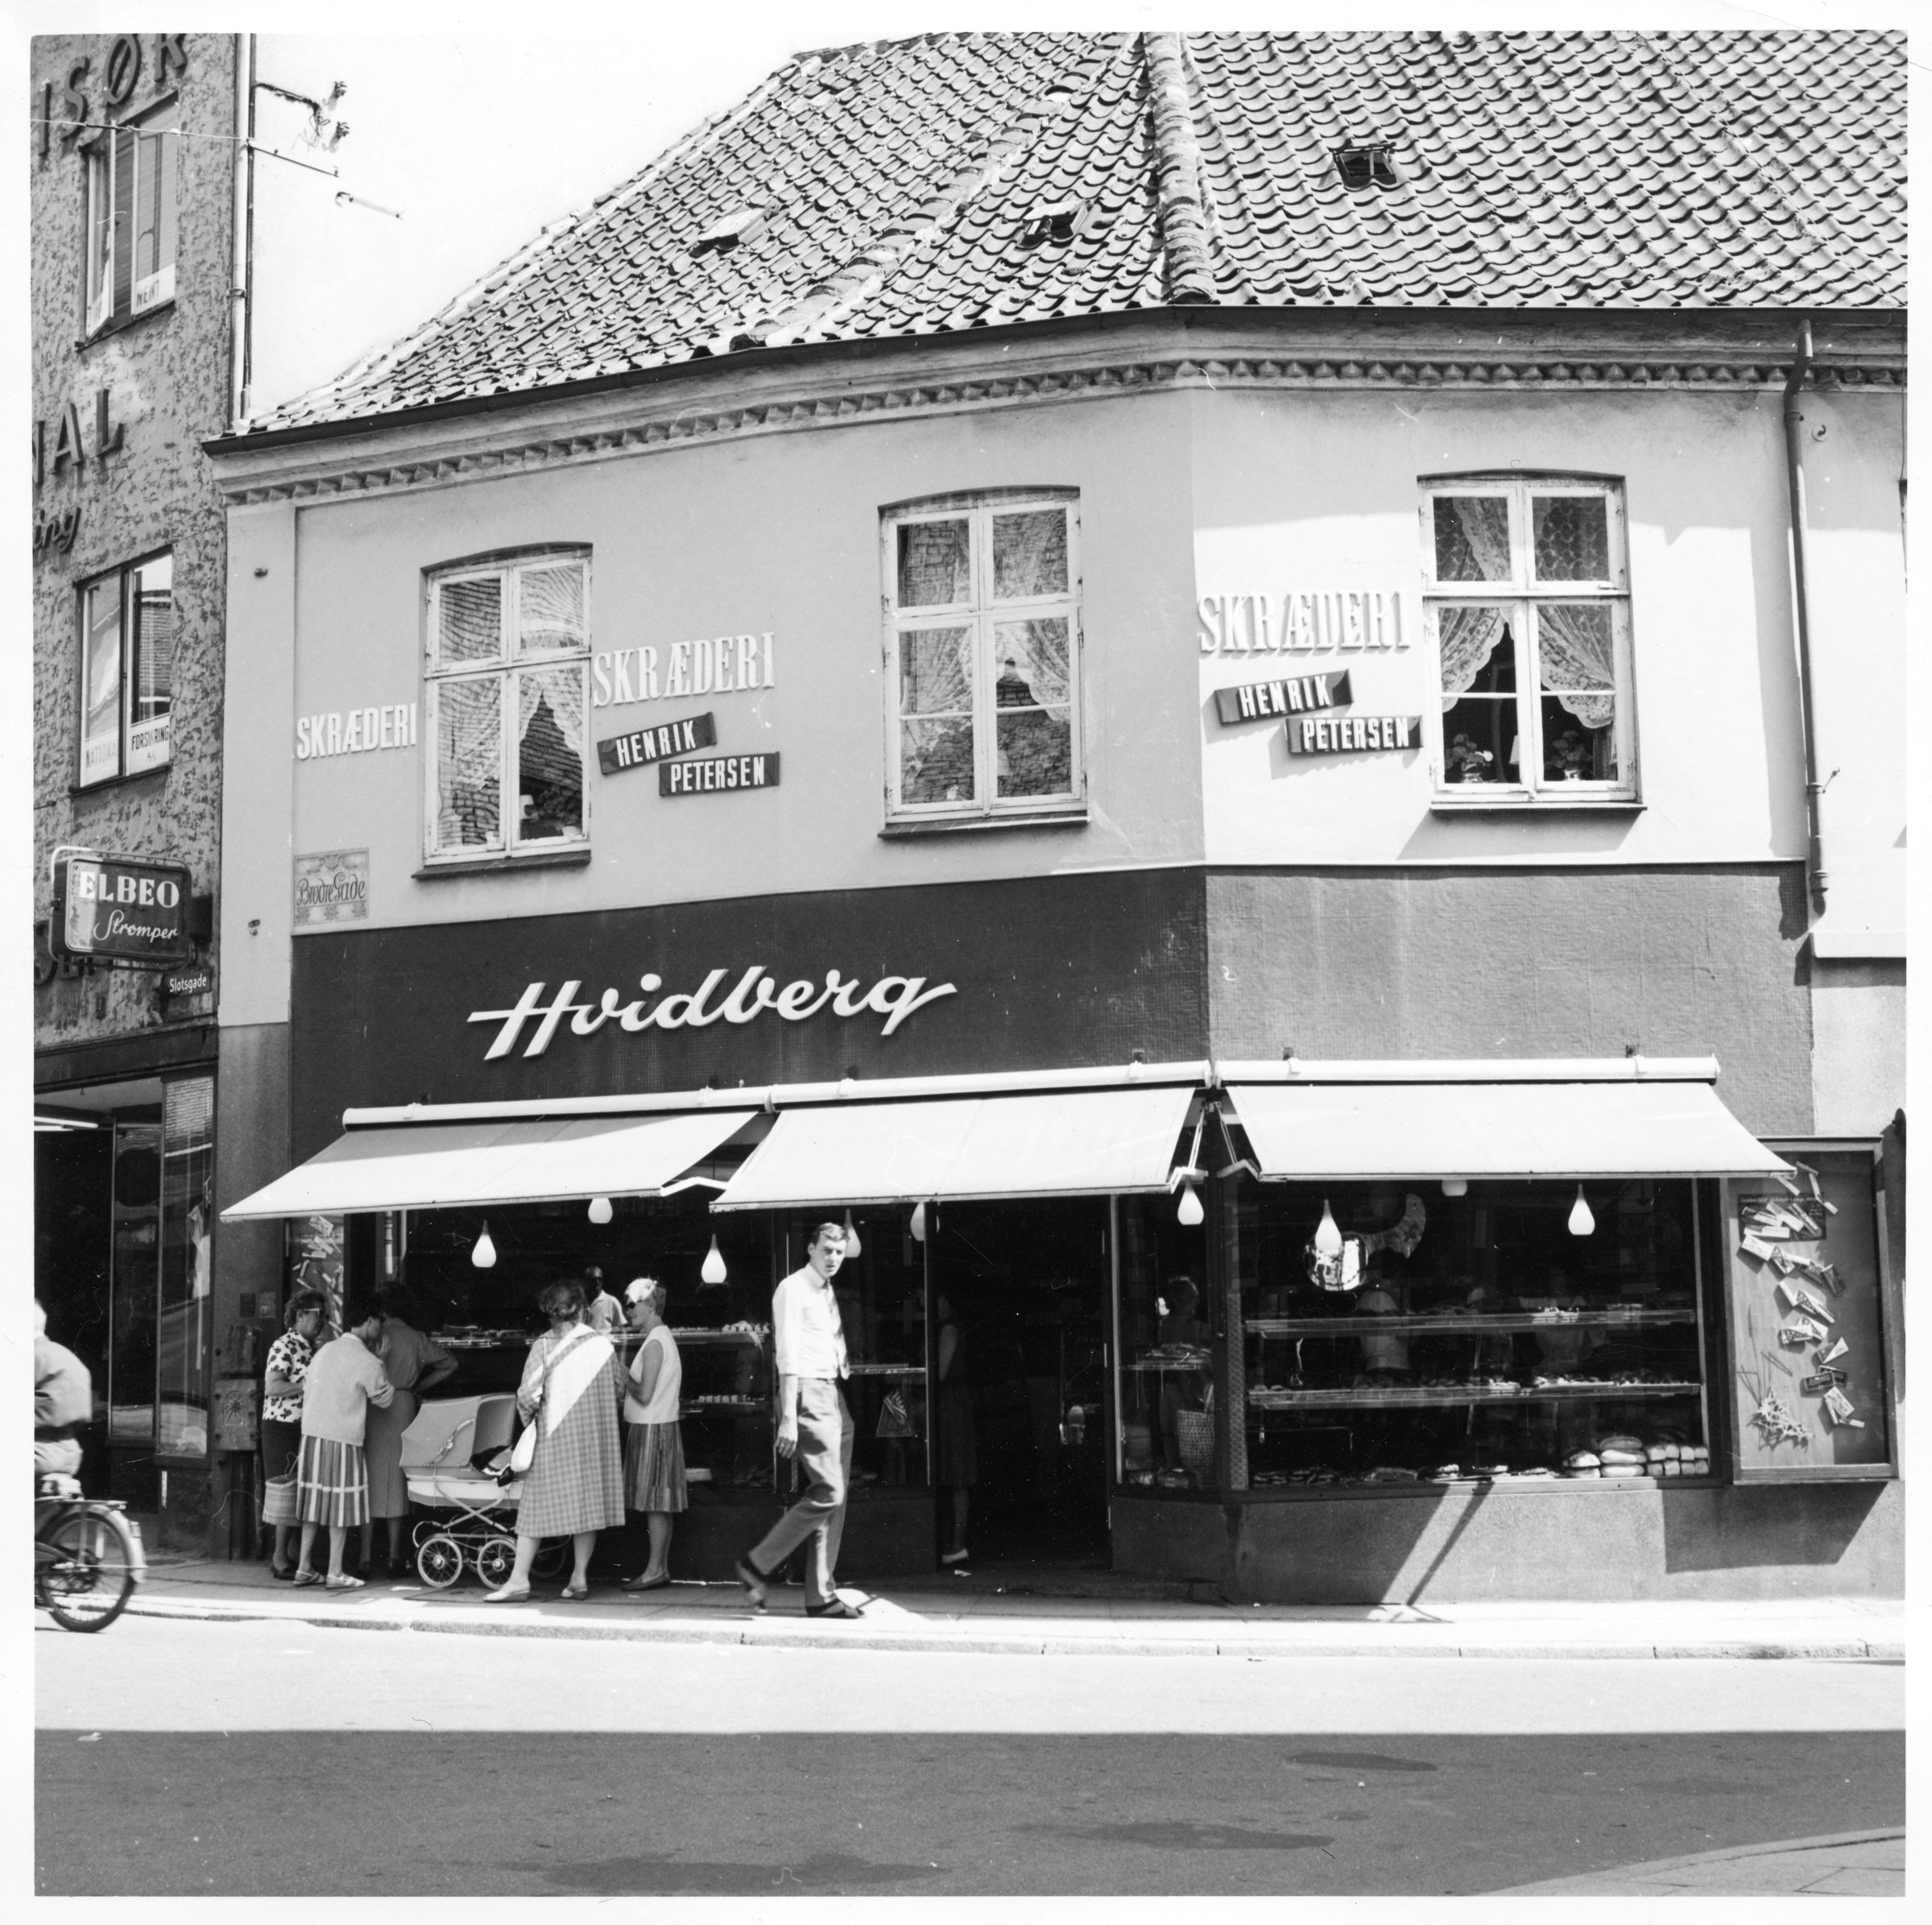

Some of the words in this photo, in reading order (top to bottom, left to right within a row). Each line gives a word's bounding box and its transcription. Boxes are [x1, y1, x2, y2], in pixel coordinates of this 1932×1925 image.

[1198, 590, 1411, 652] SKRÆDERI
[593, 631, 775, 708] SKRÆDERI
[1238, 674, 1331, 718] HENRIK
[296, 702, 417, 760] SKRÆDERI
[615, 720, 697, 767] HENRIK
[1301, 716, 1410, 751] PETERSEN
[670, 756, 766, 793] PETERSEN
[79, 871, 180, 909] ELBEO
[169, 972, 207, 994] Slotsgade
[466, 966, 958, 1062] Hvidberg
